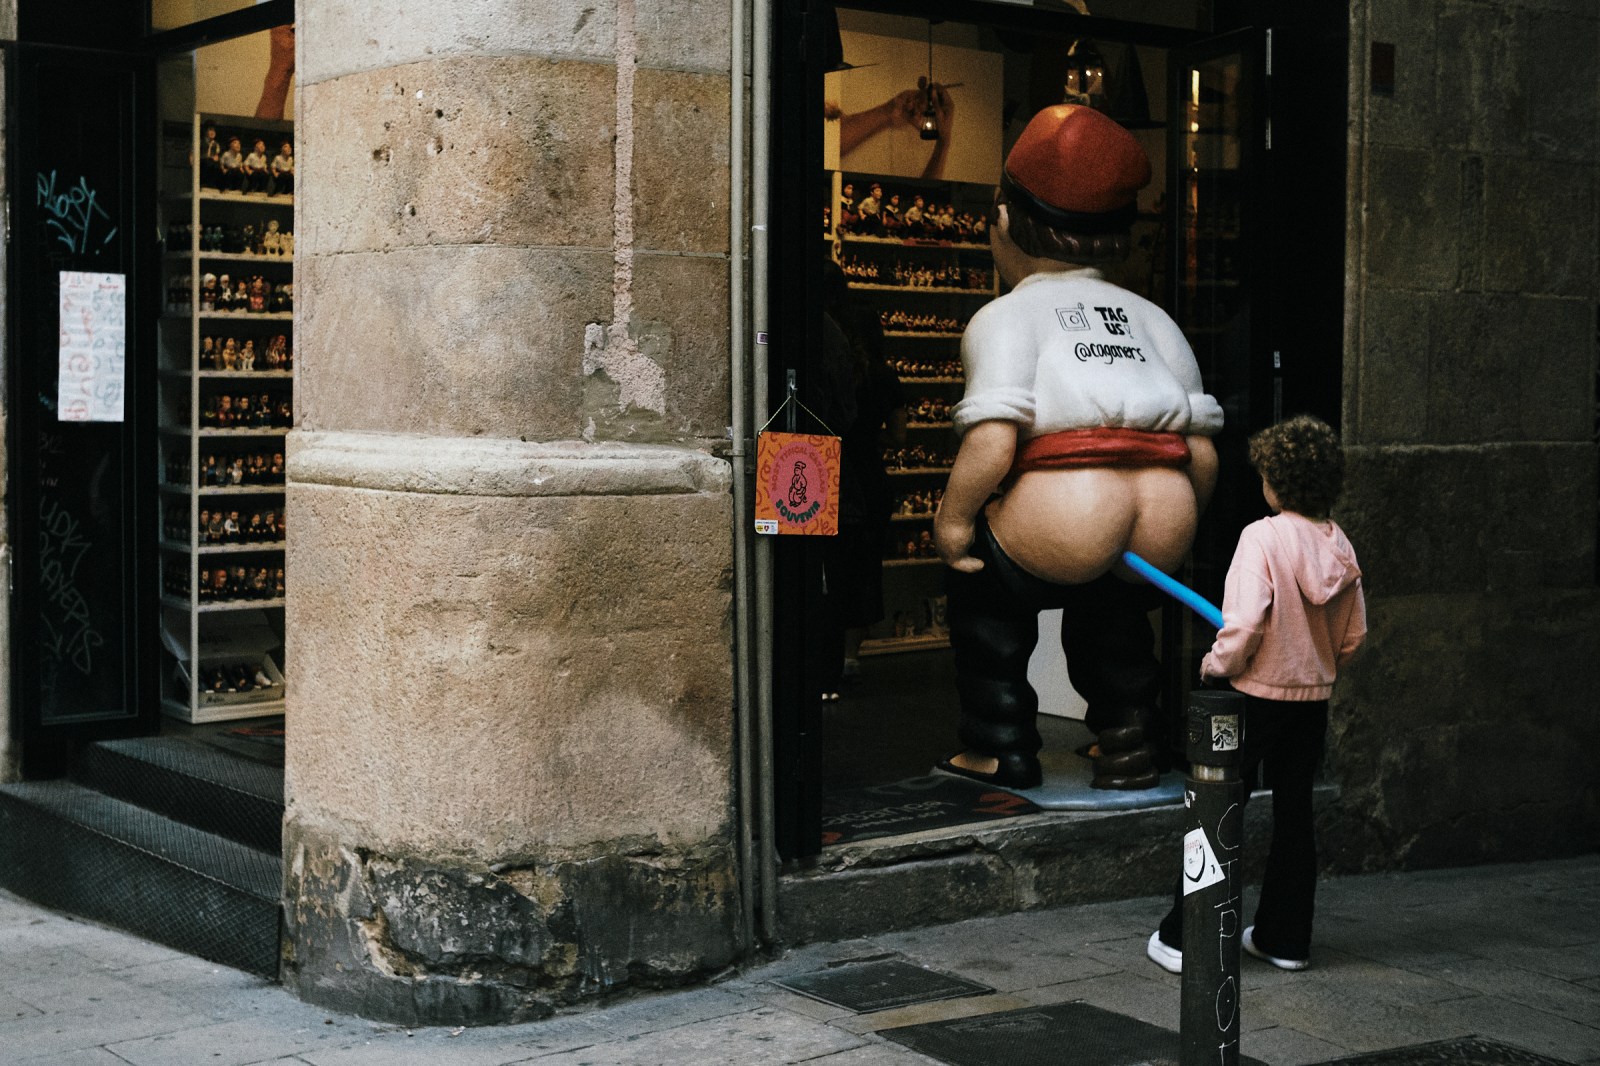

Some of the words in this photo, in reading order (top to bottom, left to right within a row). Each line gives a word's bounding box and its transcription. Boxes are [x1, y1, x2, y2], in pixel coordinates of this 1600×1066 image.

[1094, 307, 1128, 323] TAG
[1075, 342, 1146, 365] @caganers
[775, 499, 820, 523] SOUVENIR
